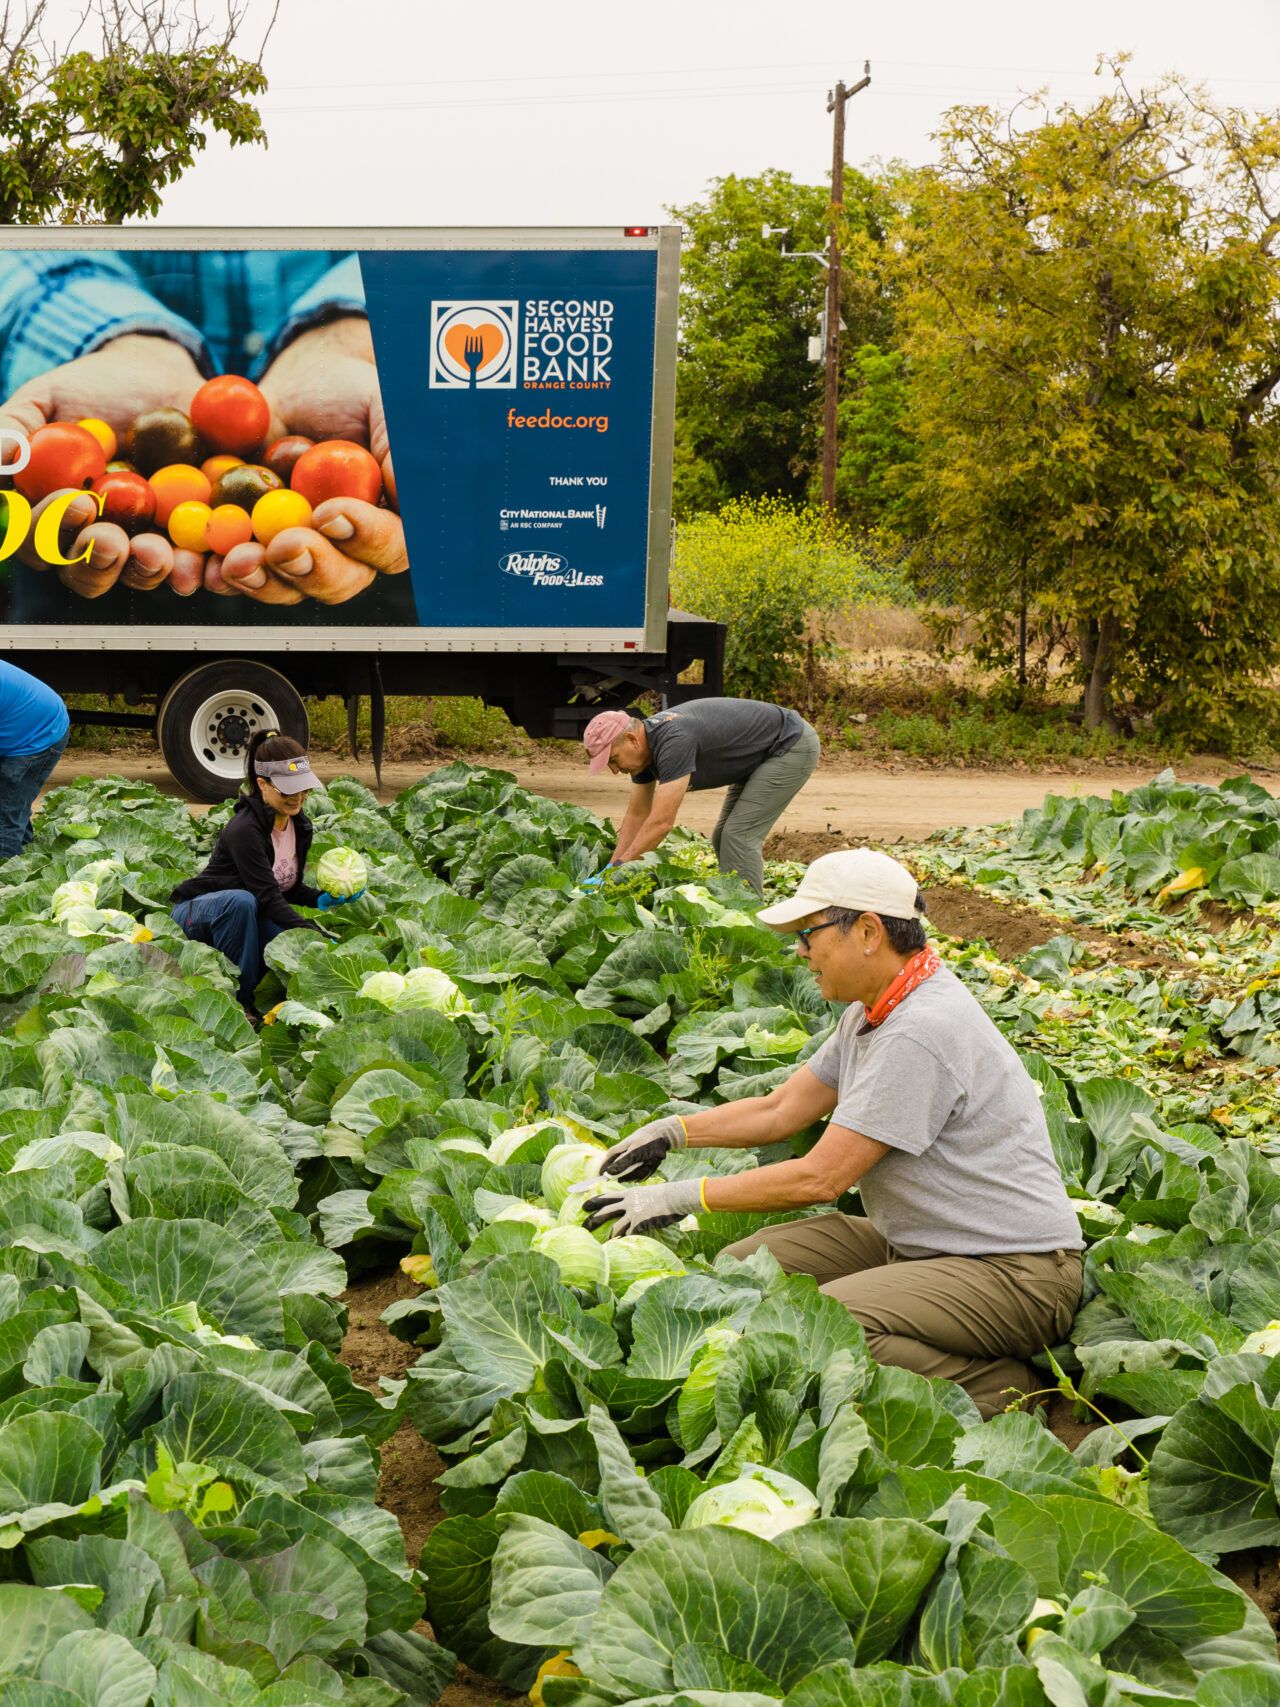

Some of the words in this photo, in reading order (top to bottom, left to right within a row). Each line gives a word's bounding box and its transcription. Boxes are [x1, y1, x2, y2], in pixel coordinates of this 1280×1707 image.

[525, 300, 614, 317] SECOND
[524, 317, 613, 333] HARVEST
[524, 333, 613, 356] FOOD
[523, 356, 611, 381] BANK
[507, 408, 609, 433] feedoc.org
[549, 477, 584, 486] THANK
[586, 477, 608, 486] YOU
[500, 509, 519, 518] CITY
[520, 509, 568, 519] NATIONAL
[567, 509, 595, 519] BANK
[505, 553, 561, 576] Ralphs
